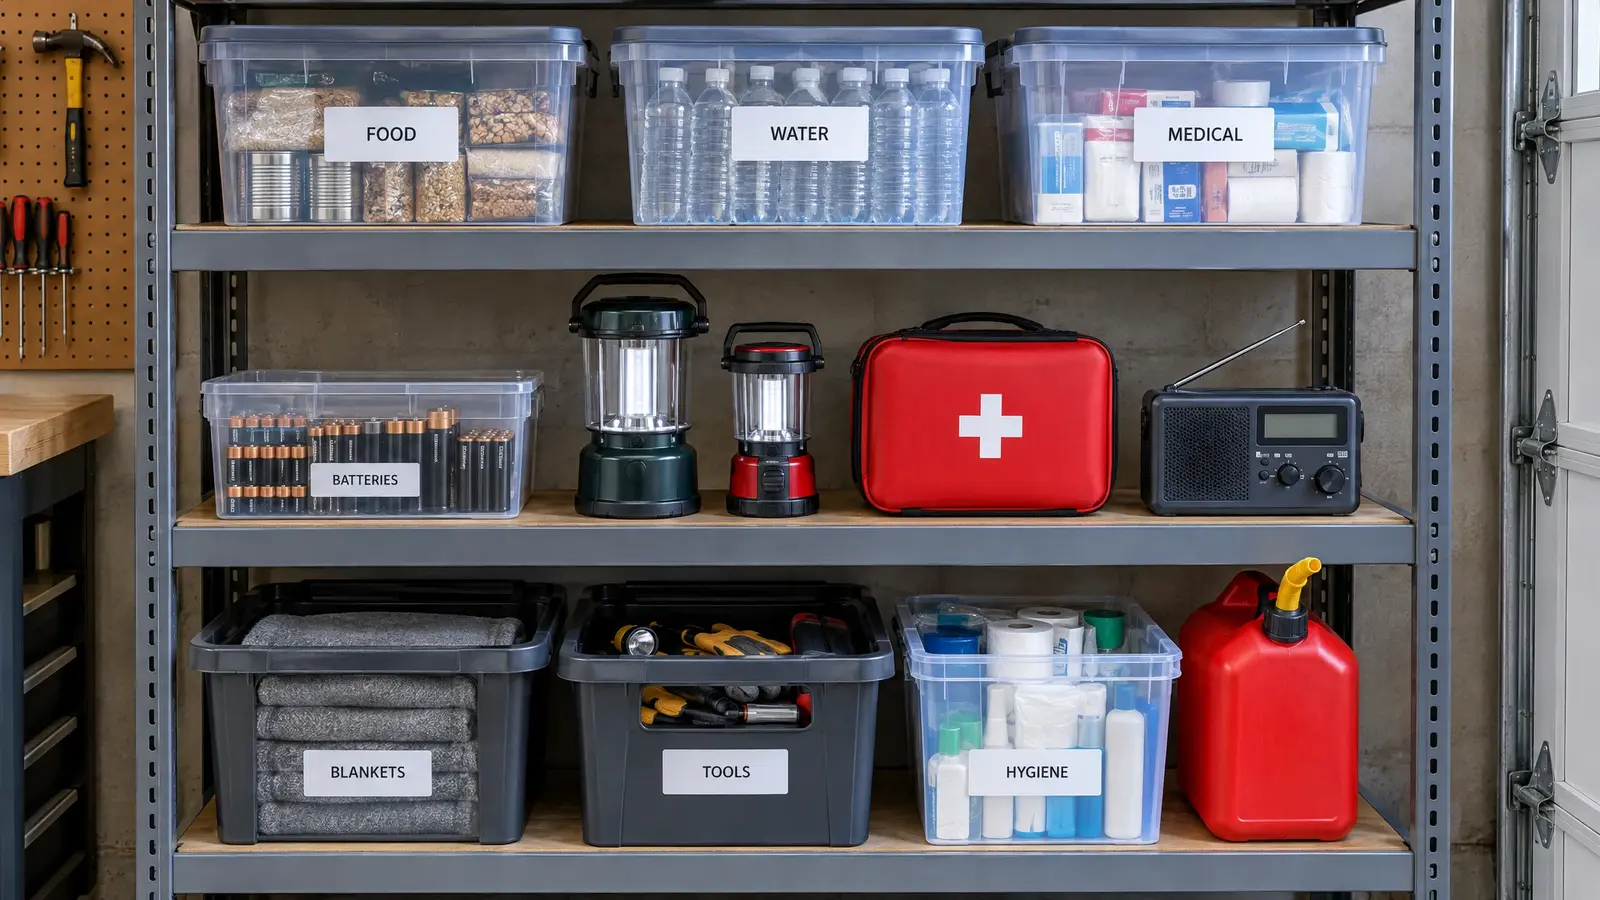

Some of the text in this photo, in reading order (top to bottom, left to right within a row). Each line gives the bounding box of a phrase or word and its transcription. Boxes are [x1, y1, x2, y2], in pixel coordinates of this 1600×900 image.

[367, 126, 417, 142] FOOD
[770, 126, 829, 141] WATER
[1168, 127, 1243, 142] MEDICAL
[332, 474, 399, 486] BATTERIES
[331, 765, 406, 779] BLANKETS
[702, 765, 751, 779] TOOLS
[1006, 765, 1069, 779] HYGIENE
